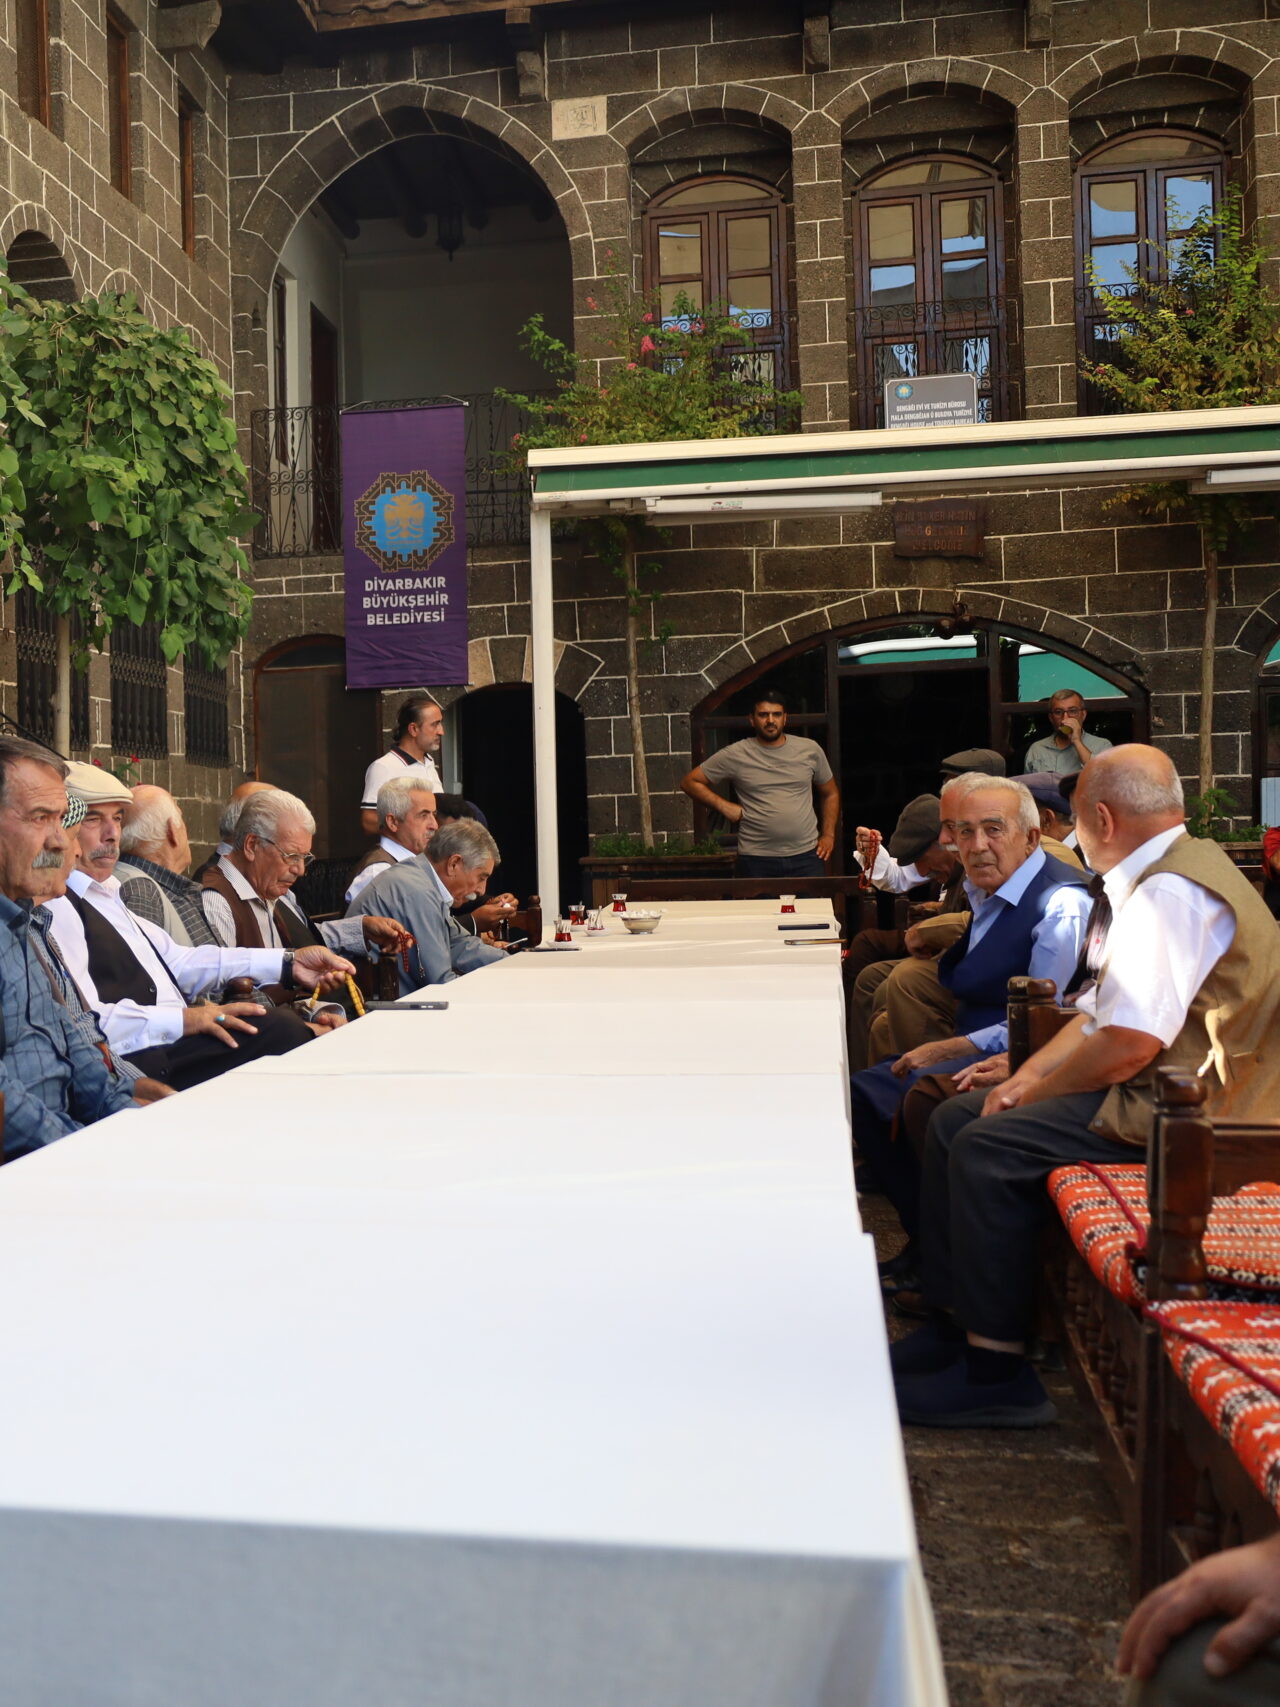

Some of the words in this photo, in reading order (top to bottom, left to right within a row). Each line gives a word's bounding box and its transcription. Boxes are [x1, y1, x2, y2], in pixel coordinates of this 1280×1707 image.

[365, 576, 446, 591] DİYARBAKIR
[363, 591, 449, 608] BÜYÜKŞEHİR
[367, 608, 445, 625] BELEDİYESİ
